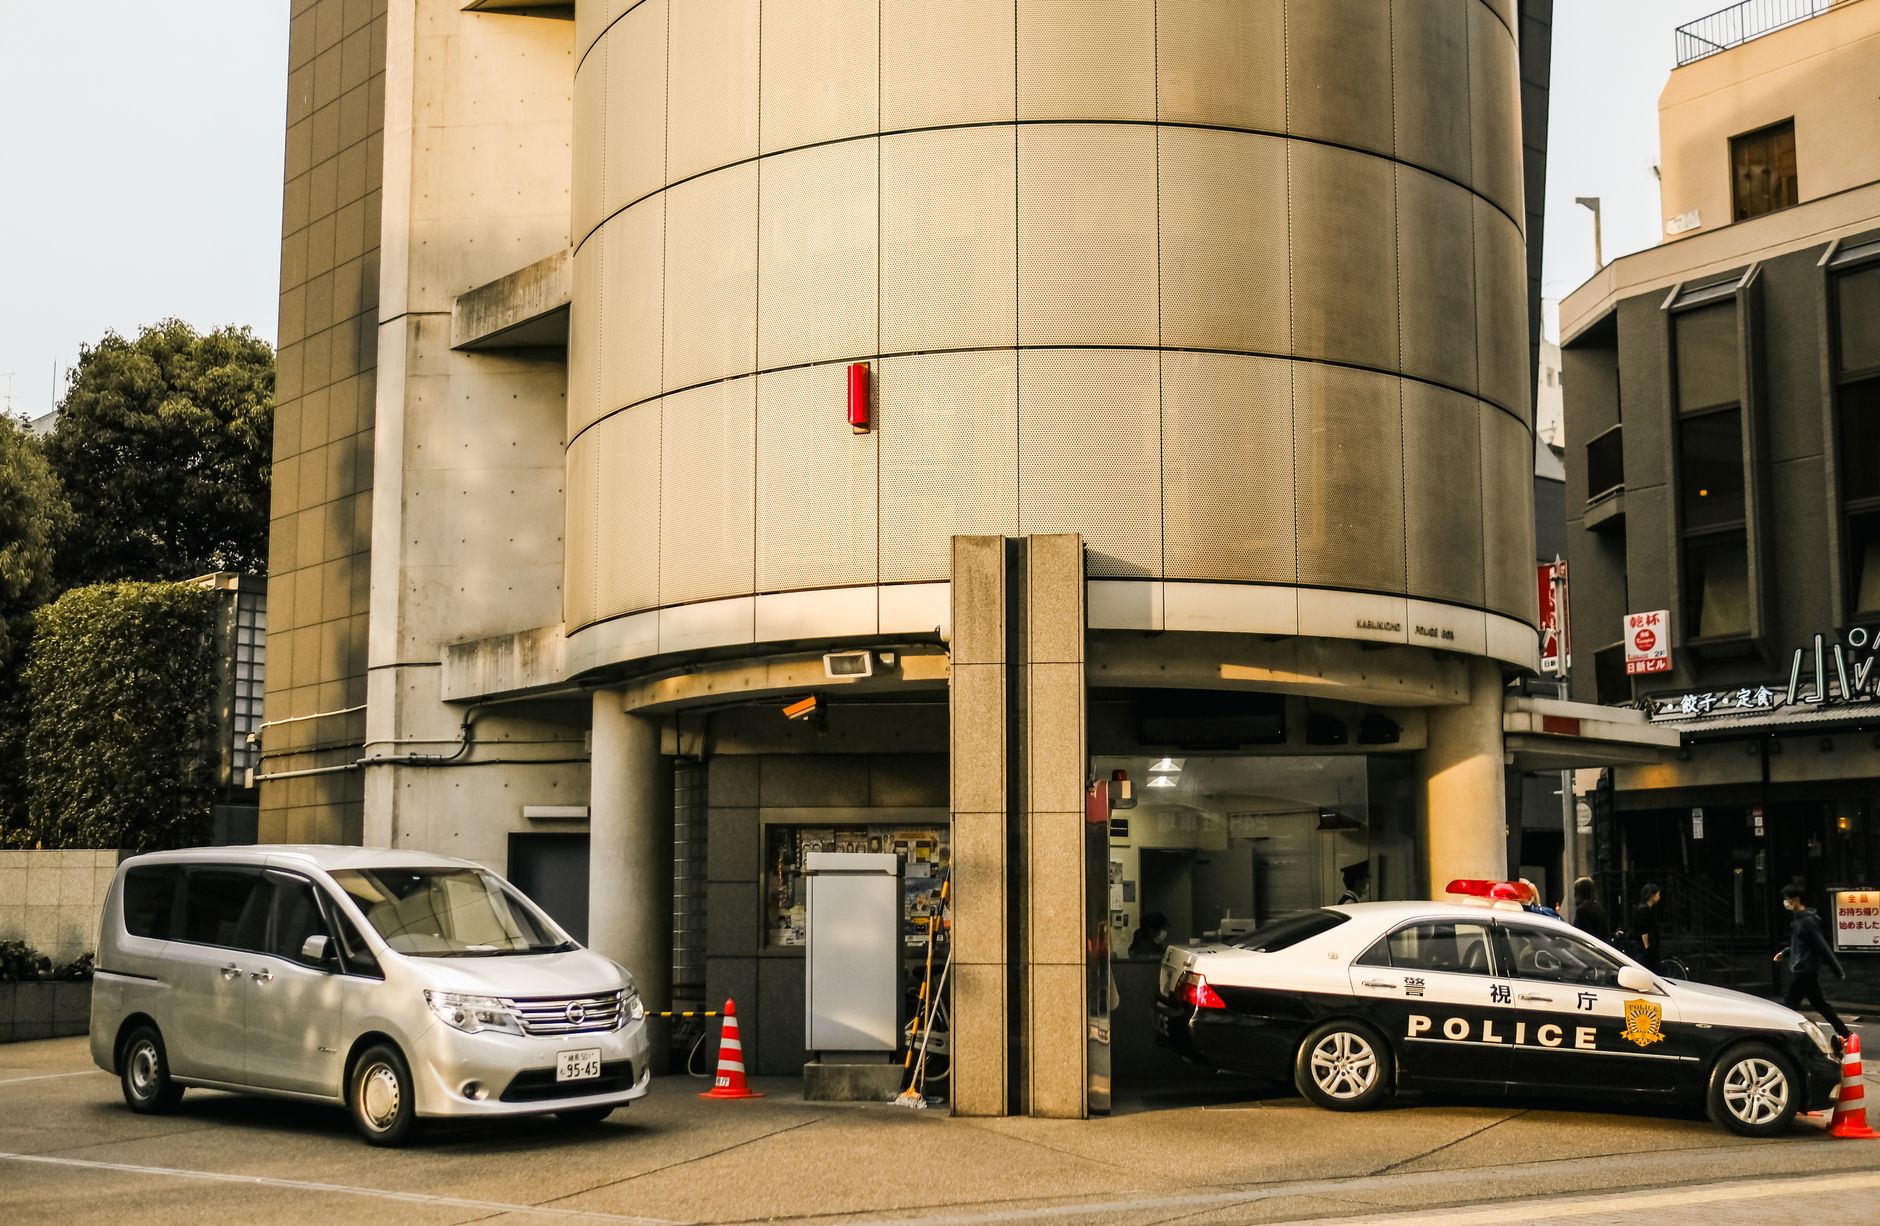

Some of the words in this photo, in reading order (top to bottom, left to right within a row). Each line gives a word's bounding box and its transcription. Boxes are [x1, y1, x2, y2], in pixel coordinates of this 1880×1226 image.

[1627, 659, 1667, 673] 日新ビル
[1847, 894, 1869, 903] 全品
[1403, 976, 1598, 1011] 警視庁
[1407, 1014, 1597, 1050] POLICE
[567, 1061, 598, 1078] 95-45
